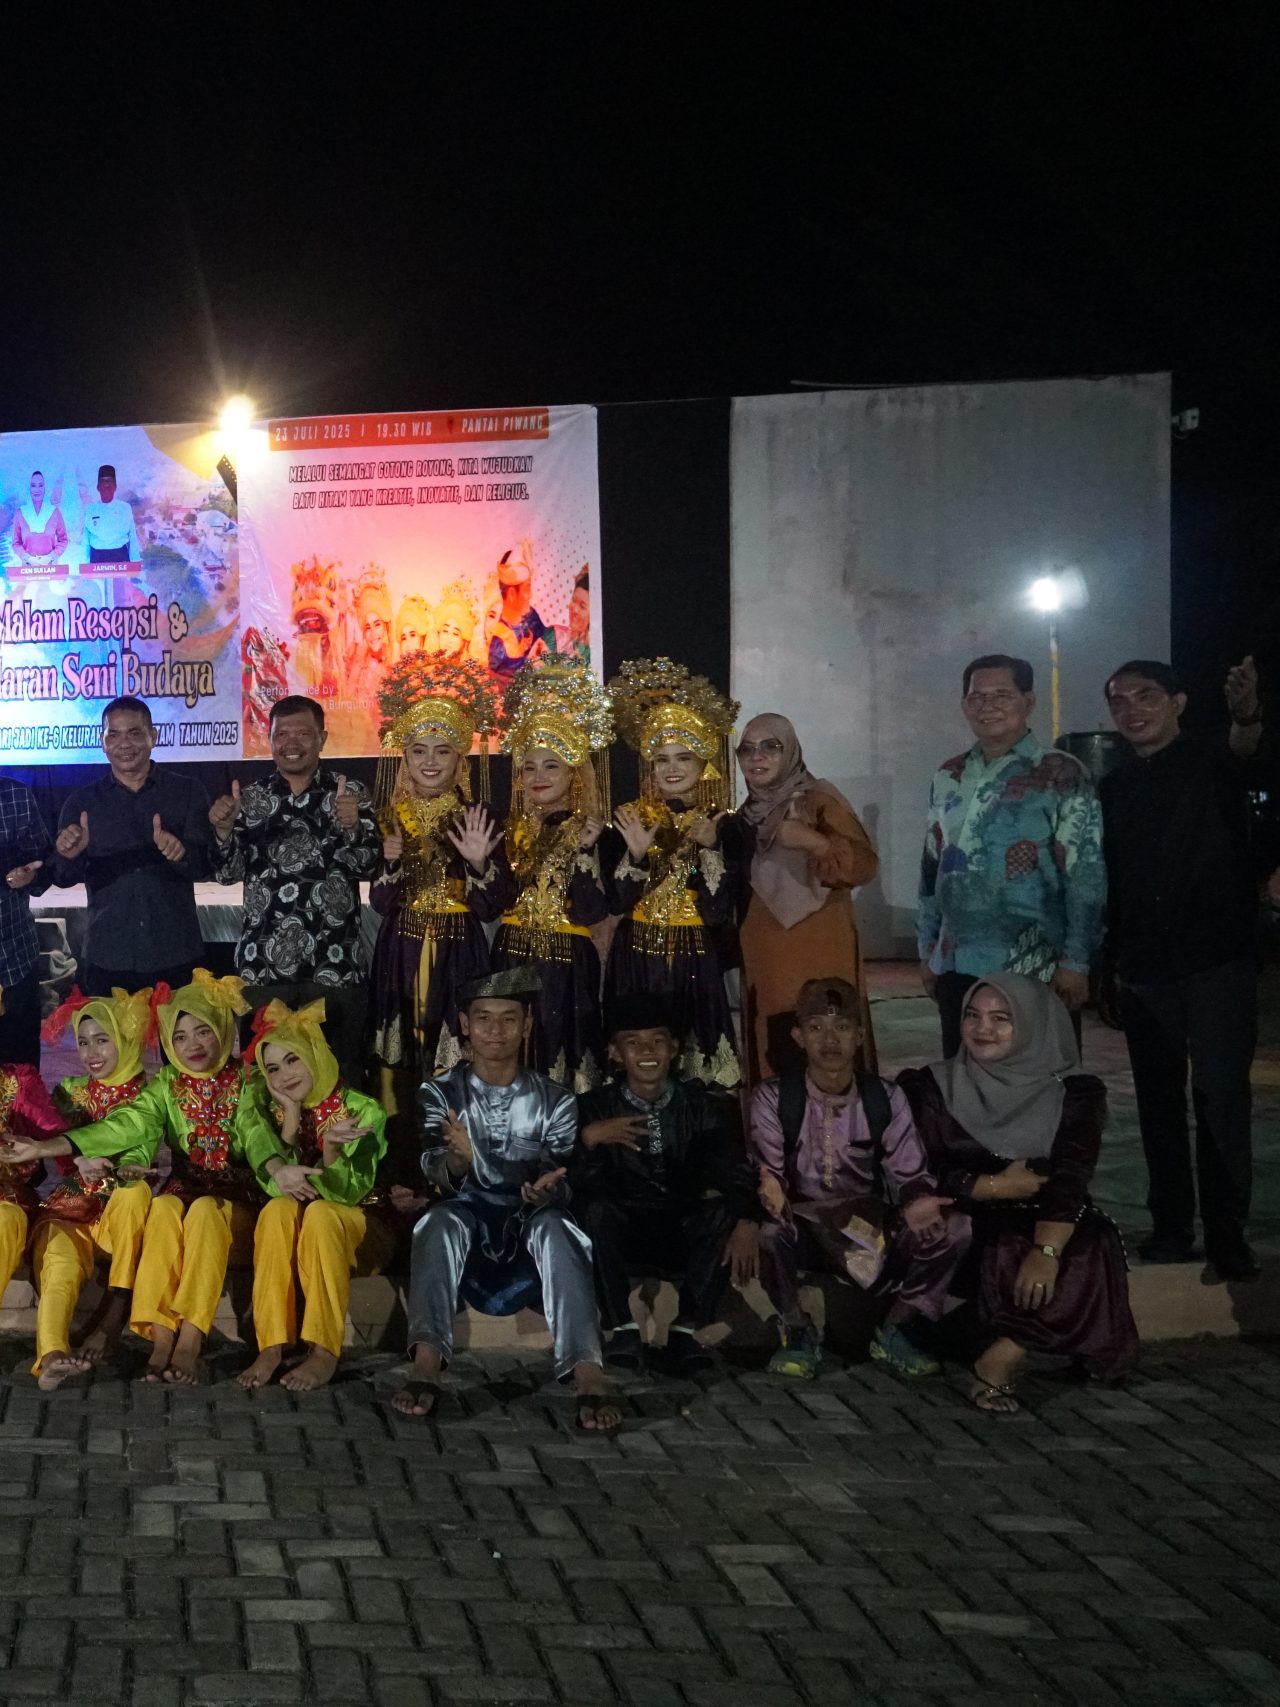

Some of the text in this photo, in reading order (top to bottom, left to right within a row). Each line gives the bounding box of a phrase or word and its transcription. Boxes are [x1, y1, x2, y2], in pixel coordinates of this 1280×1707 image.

[275, 427, 288, 442] 23
[293, 425, 318, 440] JULI
[324, 424, 351, 439] 2025
[377, 422, 407, 438] 19.30
[412, 421, 433, 436] WIB
[462, 416, 499, 433] PANTAI
[503, 415, 543, 431] PIWANG
[289, 456, 533, 483] MELALUI SEMANGAT GOTONG ROYONG, KITA WUJUDKAN
[292, 491, 316, 509] BATU
[318, 490, 348, 508] HITAM
[350, 489, 374, 507] YANG
[464, 485, 484, 502] DAN
[68, 593, 158, 650] Resepsi
[167, 601, 188, 643] &
[62, 650, 117, 701] Seni
[121, 650, 216, 709] Budaya
[13, 726, 36, 750] JADI
[37, 725, 60, 749] KE-6
[179, 722, 212, 746] TAHUN
[213, 721, 238, 745] 2025
